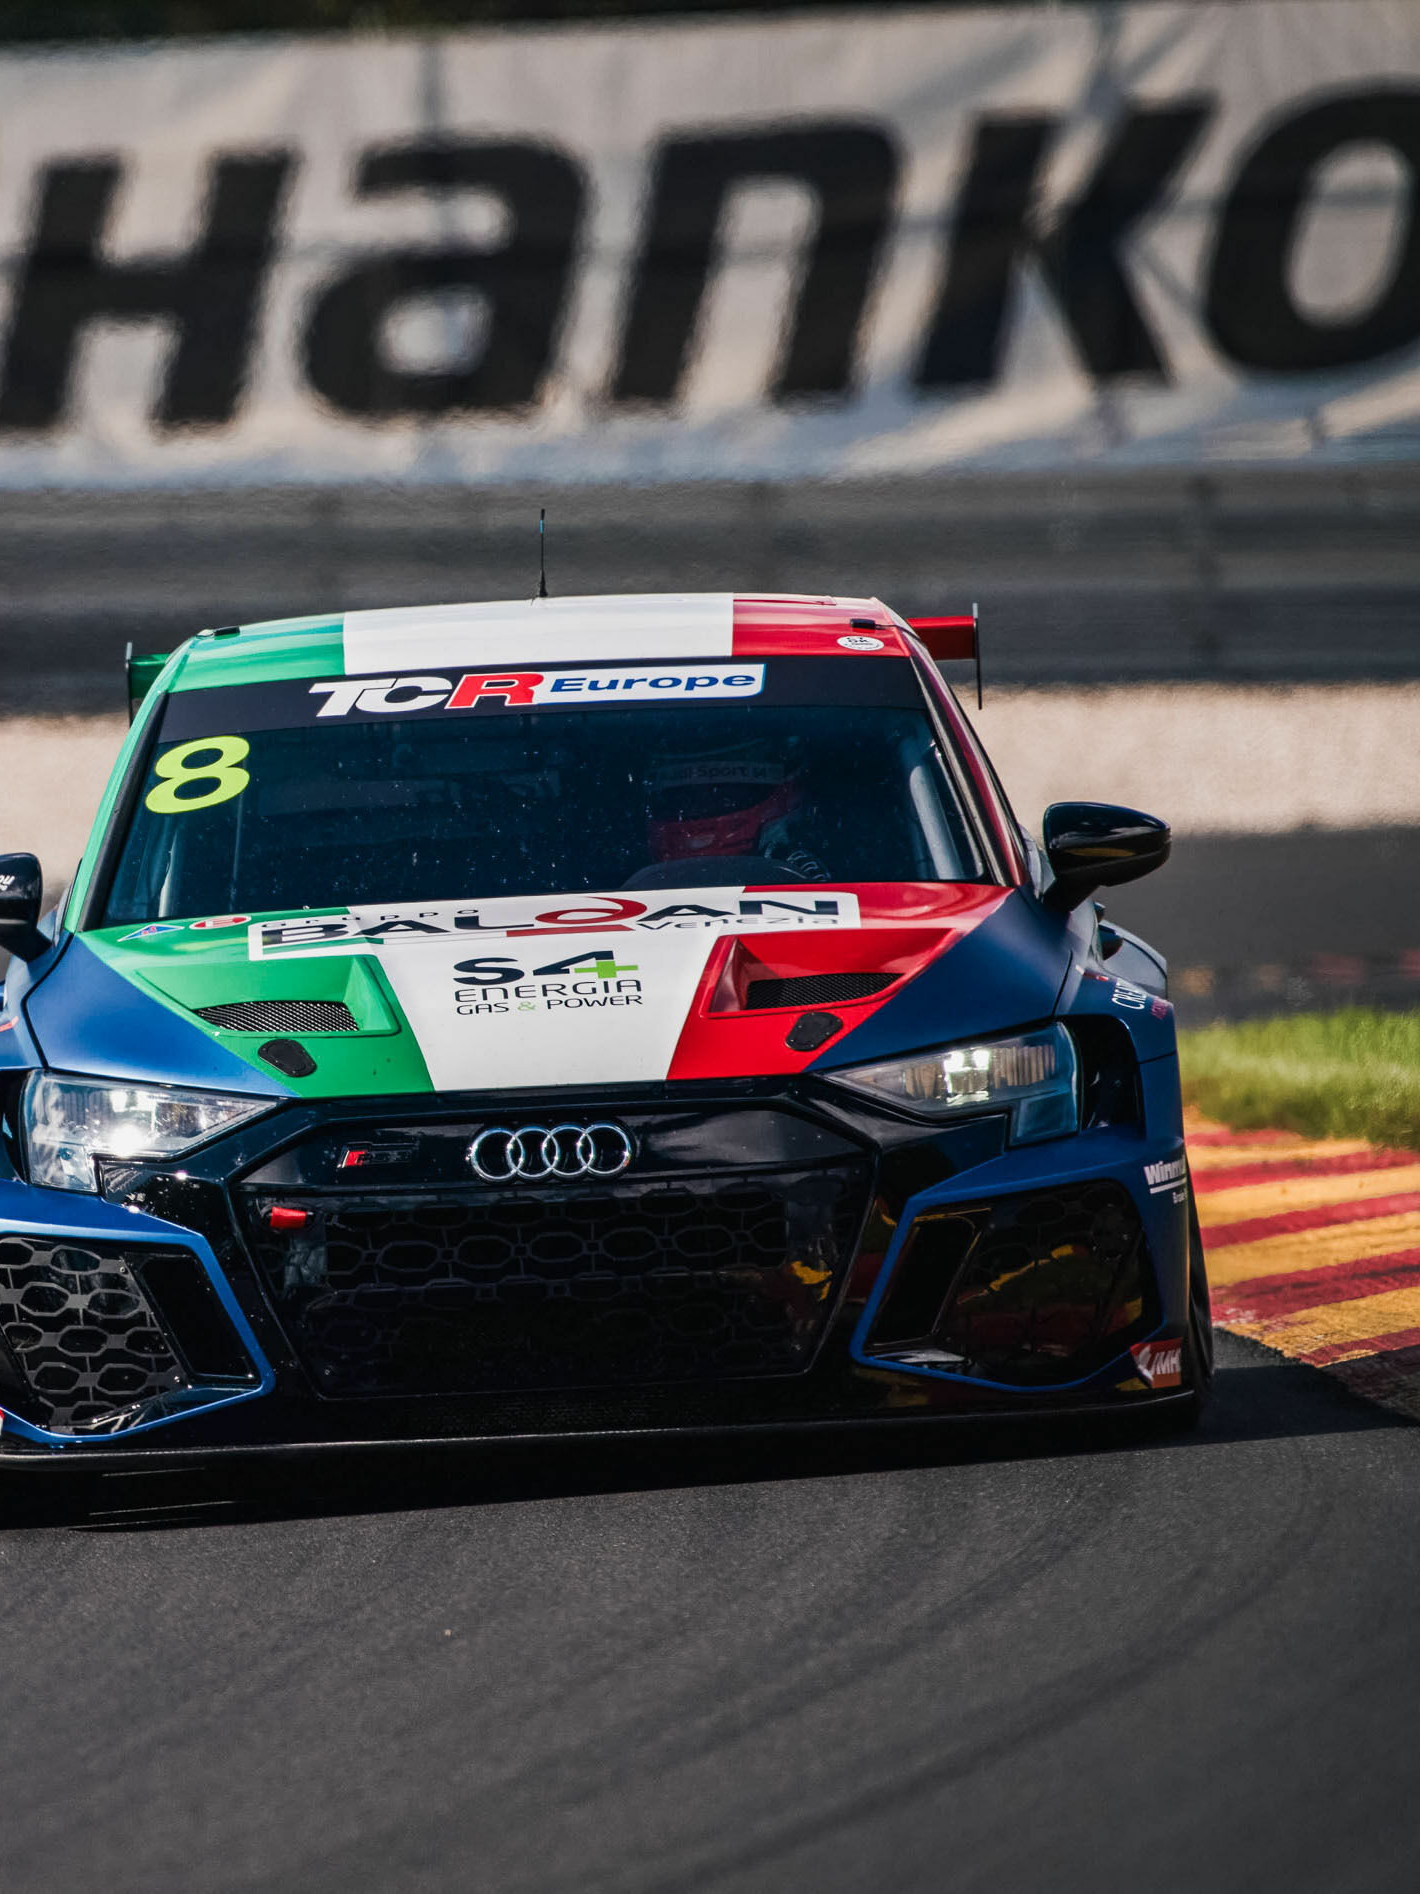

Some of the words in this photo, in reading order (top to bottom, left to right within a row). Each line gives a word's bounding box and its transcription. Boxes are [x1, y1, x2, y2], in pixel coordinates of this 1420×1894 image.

[308, 672, 544, 717] TCR
[549, 671, 757, 693] Europe
[144, 735, 250, 814] 8
[636, 917, 838, 930] Venezia
[454, 979, 643, 1003] ENERGIA
[456, 1002, 510, 1016] GAS
[517, 1001, 537, 1012] &
[546, 994, 644, 1010] POWER
